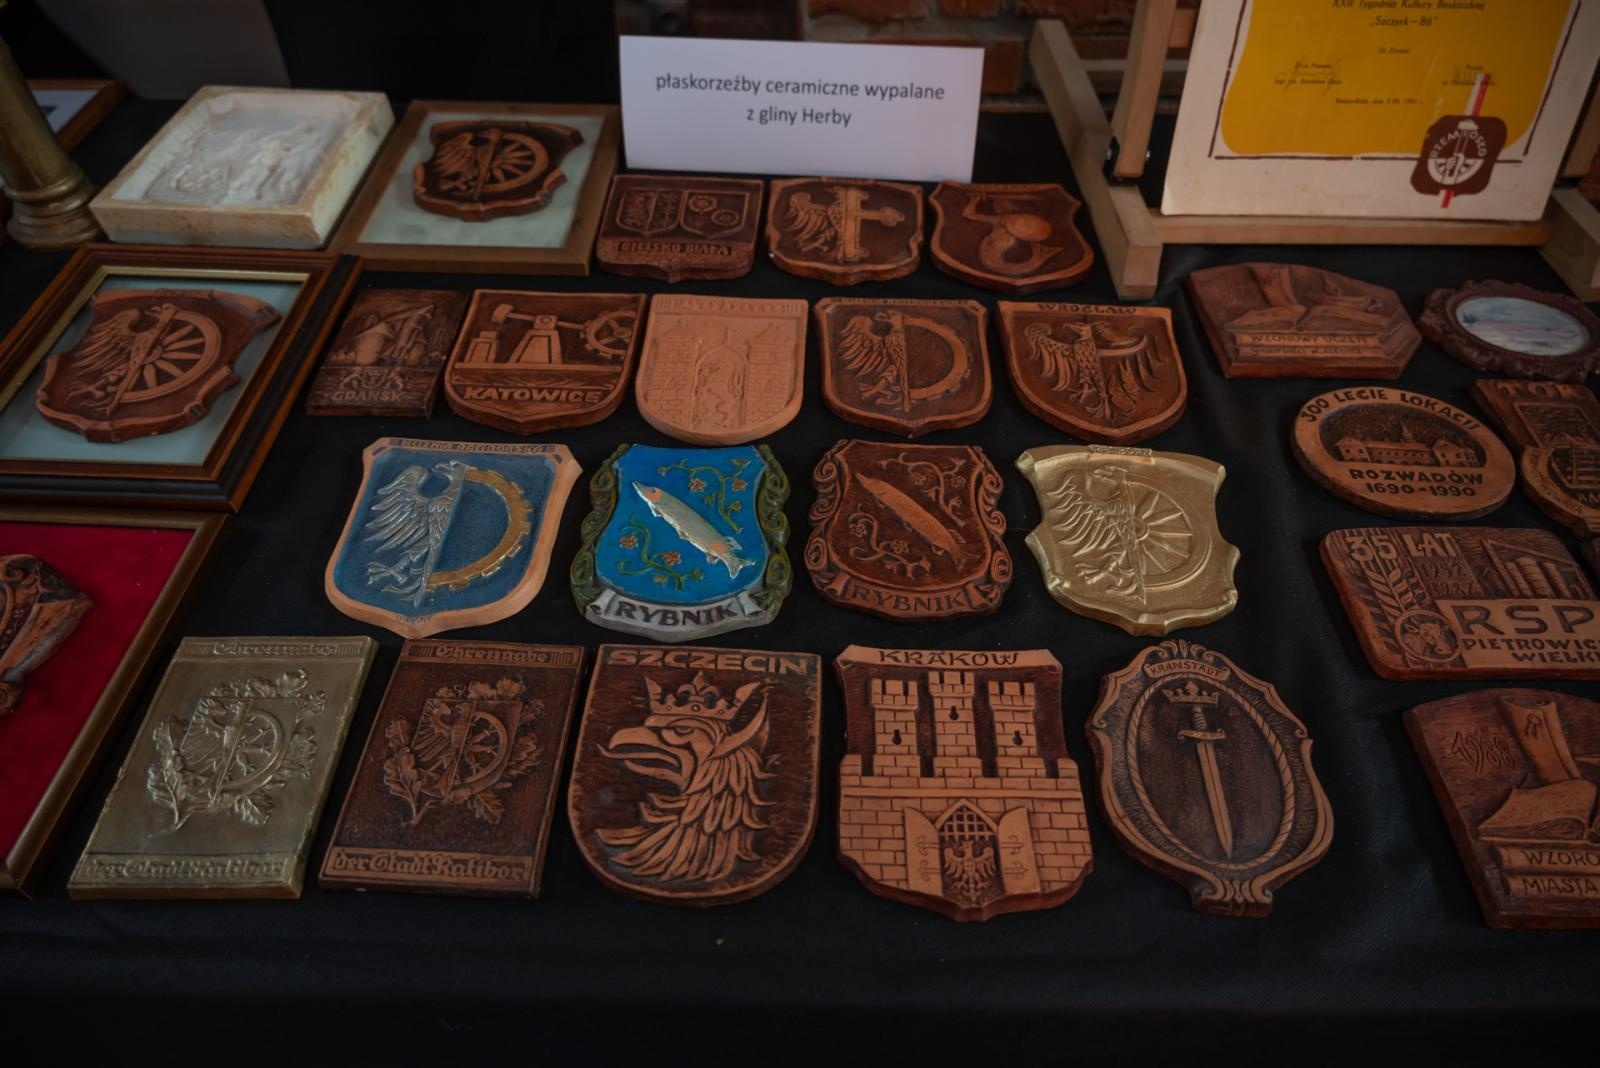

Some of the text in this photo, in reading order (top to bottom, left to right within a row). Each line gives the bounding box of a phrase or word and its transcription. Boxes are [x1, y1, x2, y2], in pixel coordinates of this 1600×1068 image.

[656, 73, 945, 100] płaskorzeźby ceramiczne wypalane
[747, 105, 852, 127] z gliny Herby
[463, 386, 602, 403] KATOWICE
[1301, 398, 1330, 423] 300
[1333, 388, 1388, 403] LECIE
[1349, 467, 1484, 485] ROZWADÓW
[1346, 532, 1458, 562] 35 LAT
[851, 585, 963, 612] RYBNIK
[615, 600, 738, 626] RYBNIK
[1451, 605, 1595, 636] RSP
[1461, 638, 1600, 651] PIETROWIC
[608, 650, 807, 674] SZCZECIN
[1523, 878, 1599, 894] MIASTA
